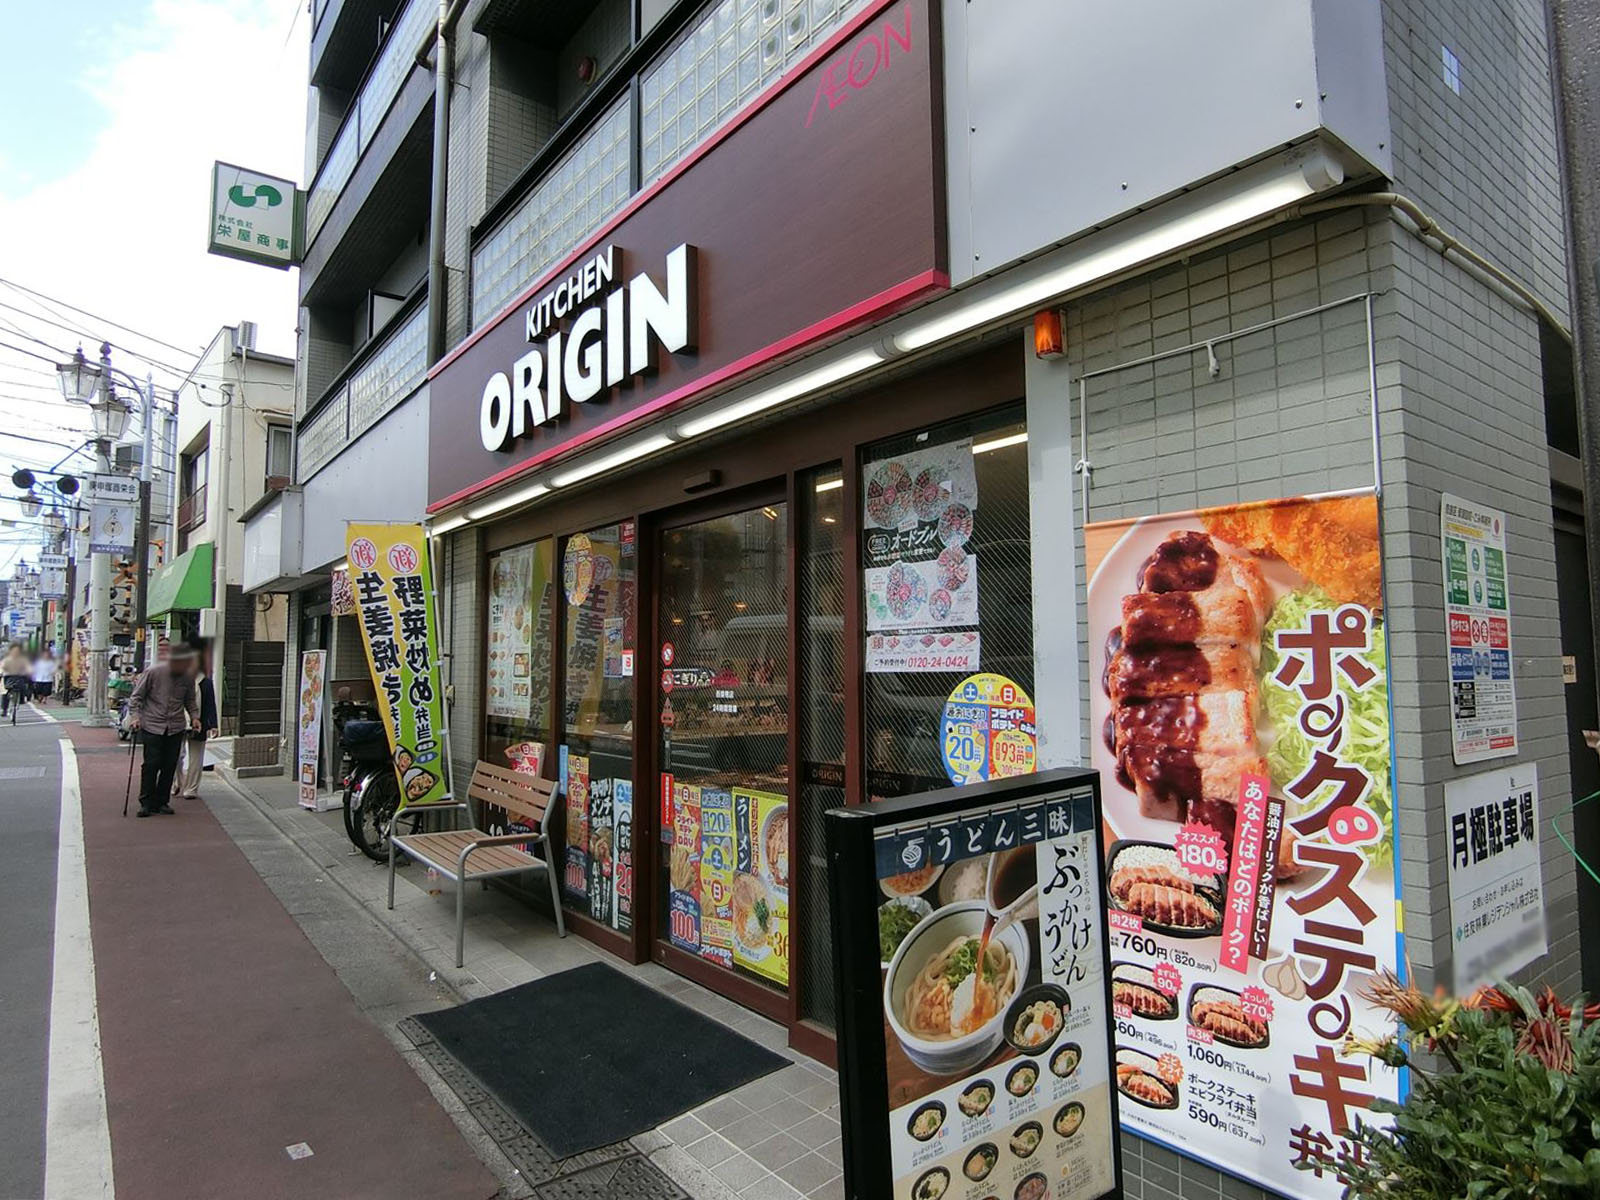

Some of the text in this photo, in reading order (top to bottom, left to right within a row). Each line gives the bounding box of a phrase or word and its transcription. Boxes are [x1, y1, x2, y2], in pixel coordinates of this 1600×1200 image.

[218, 213, 253, 229] 株式会社
[216, 223, 289, 251] 栄屋商事
[526, 244, 613, 342] KITCHEN
[480, 243, 688, 452] ORIGIN
[891, 526, 938, 550] オードブル
[908, 656, 969, 668] 0120-24-0424
[991, 708, 1025, 720] フライド
[736, 797, 749, 870] ラーメン
[1181, 832, 1218, 845] オススメ!
[1452, 791, 1534, 870] 月極駐車場
[1179, 843, 1225, 871] 180g
[1229, 781, 1263, 965] あなたはどのポーク?
[1254, 802, 1282, 955] 醤油ガーリックが香ばしい!
[1111, 915, 1140, 931] 肉2枚
[1119, 931, 1168, 961] 760円
[1242, 1003, 1272, 1021] 270g
[1187, 1073, 1256, 1105] ポークステーキ
[1188, 1085, 1257, 1120] エビフライ弁当
[1188, 1105, 1228, 1132] 590円
